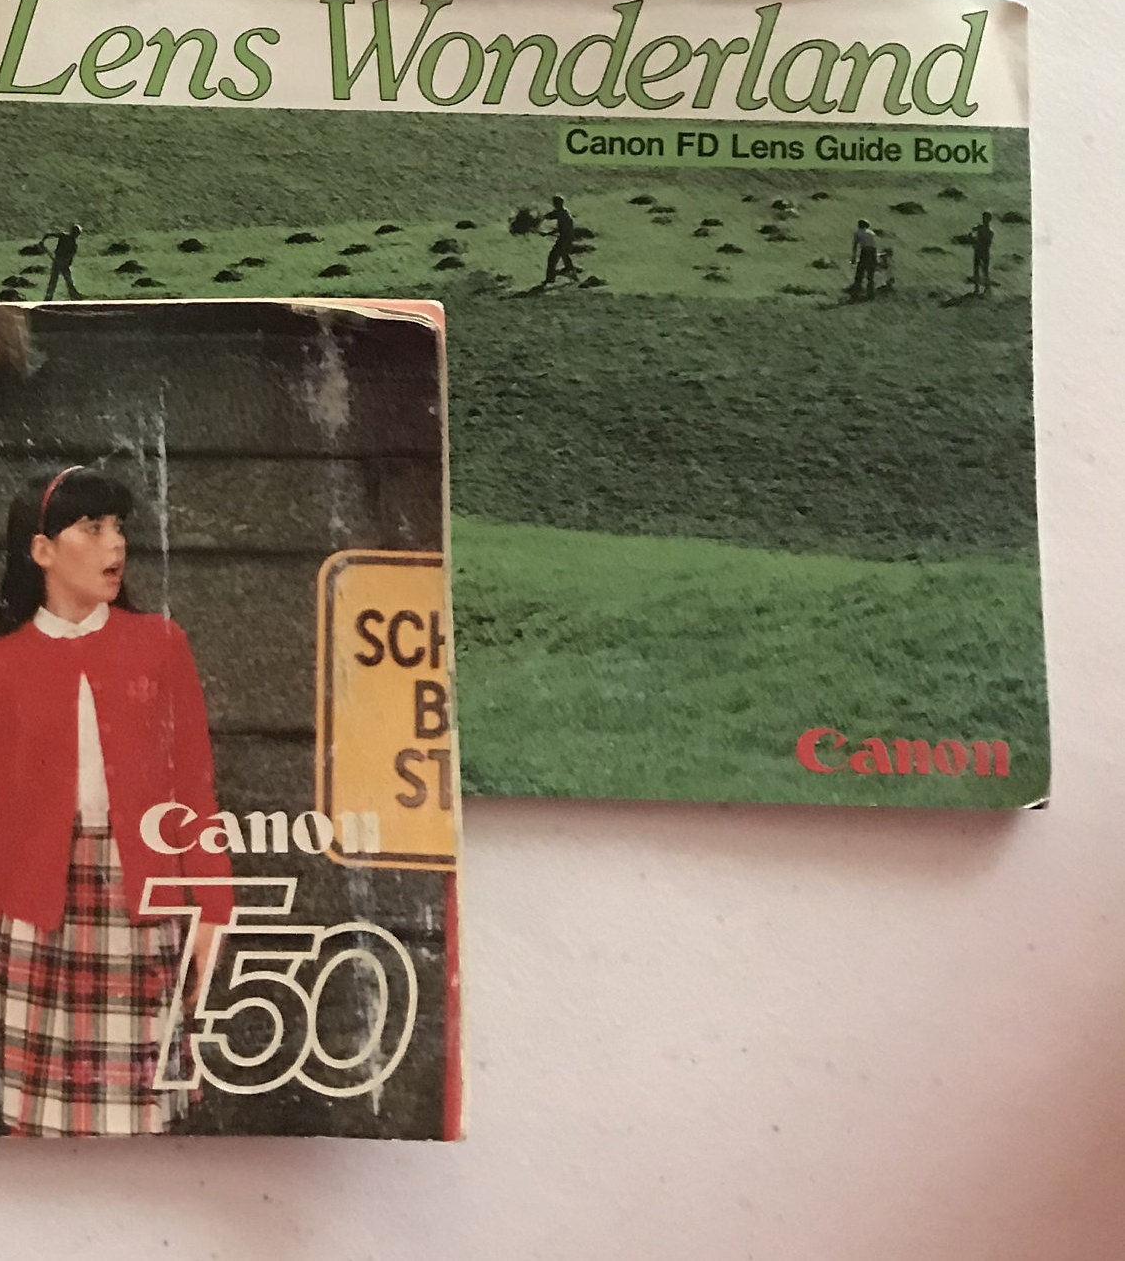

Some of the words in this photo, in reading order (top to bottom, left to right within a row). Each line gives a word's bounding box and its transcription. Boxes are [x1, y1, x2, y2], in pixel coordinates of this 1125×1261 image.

[565, 128, 665, 160] Canon
[677, 132, 718, 159] FD
[731, 132, 805, 162] Lens
[815, 135, 901, 164] Guide
[914, 138, 990, 165] Book
[796, 728, 1009, 777] Canon
[140, 802, 381, 855] Canon
[139, 876, 419, 1098] T50
